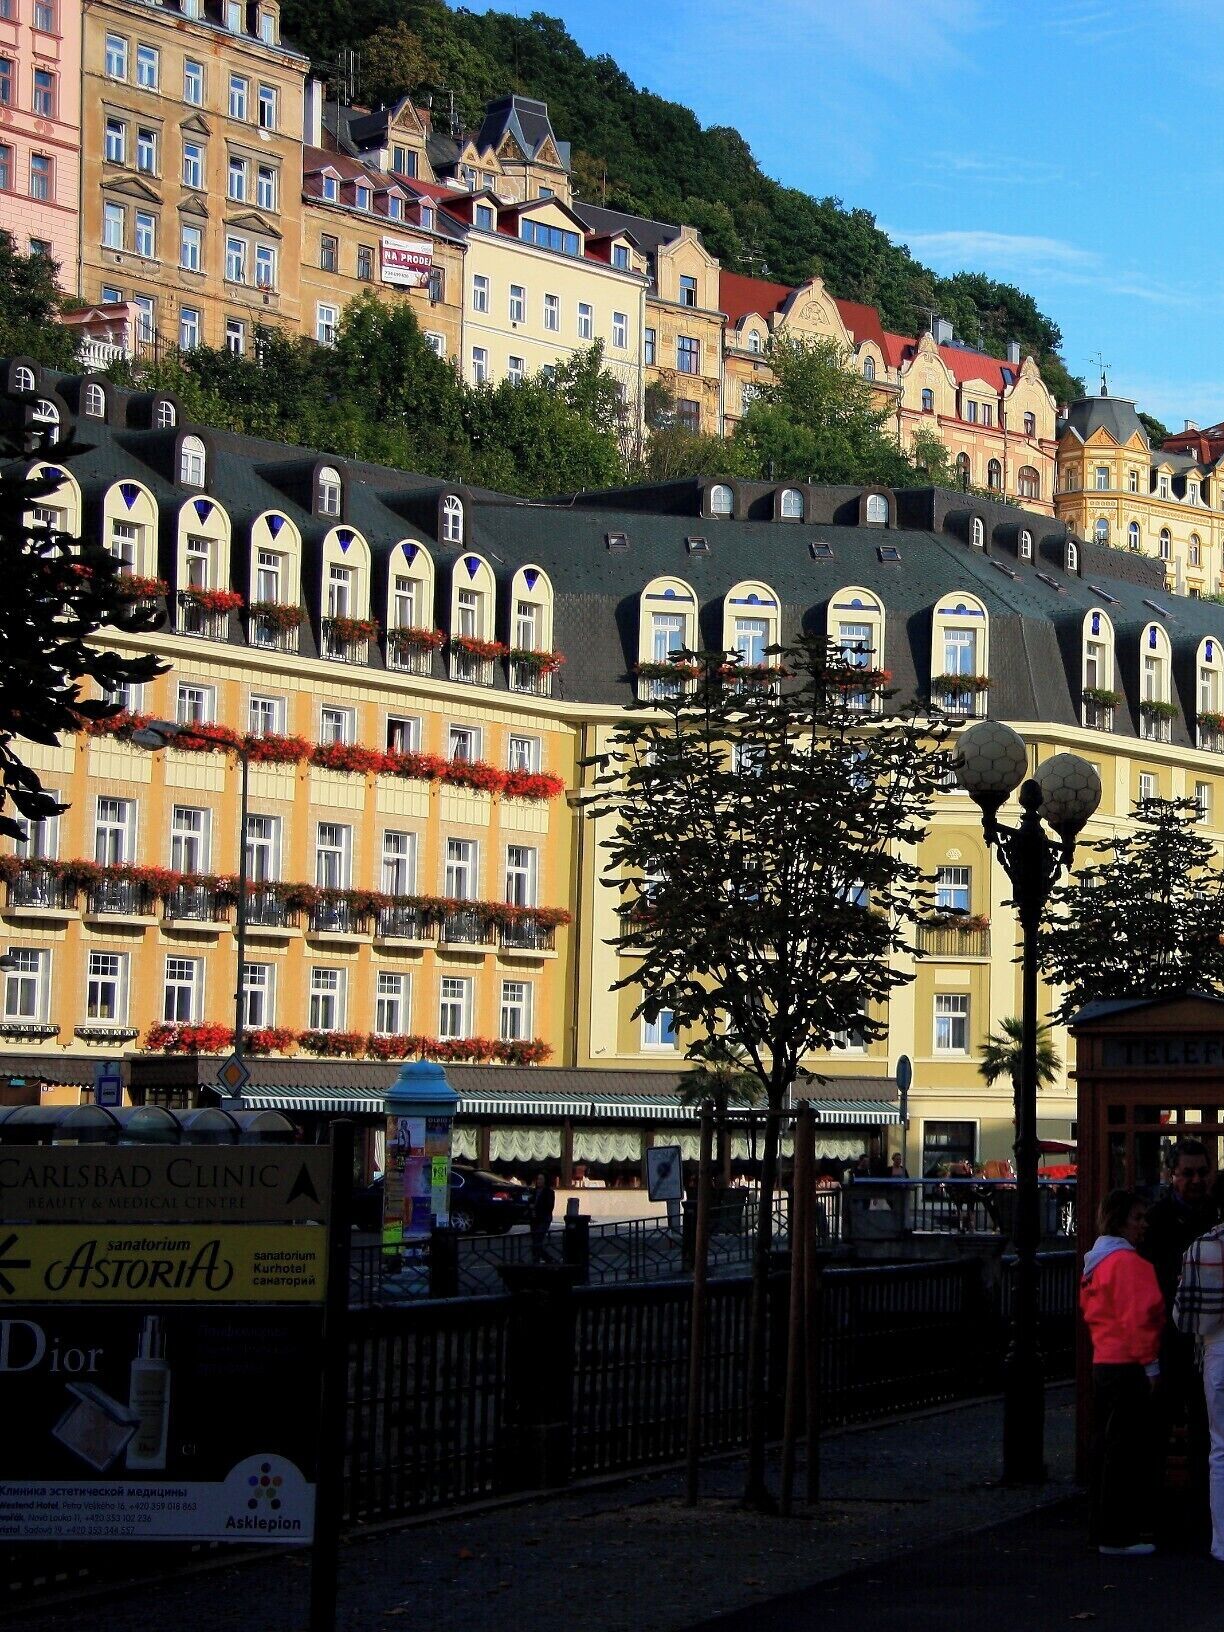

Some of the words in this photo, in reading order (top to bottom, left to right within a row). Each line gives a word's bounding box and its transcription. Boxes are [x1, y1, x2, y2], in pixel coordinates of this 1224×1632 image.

[384, 250, 397, 261] NA
[400, 253, 432, 267] PRODEJ
[0, 1158, 152, 1189] CARLSBAD
[166, 1158, 280, 1189] CLINIC
[28, 1196, 86, 1210] BEAUTY
[91, 1196, 104, 1209] &
[108, 1196, 178, 1210] MEDICAL
[184, 1196, 247, 1210] CENTRE
[107, 1236, 192, 1252] sanatorium
[253, 1250, 316, 1261] sanatorium
[253, 1263, 306, 1274] Kurhotel
[252, 1274, 316, 1287] санаторий
[0, 1318, 104, 1373] Dior
[0, 1485, 47, 1497] Клиника
[49, 1486, 124, 1497] эстетической
[127, 1487, 188, 1498] медицины
[225, 1515, 301, 1533] Asklepion
